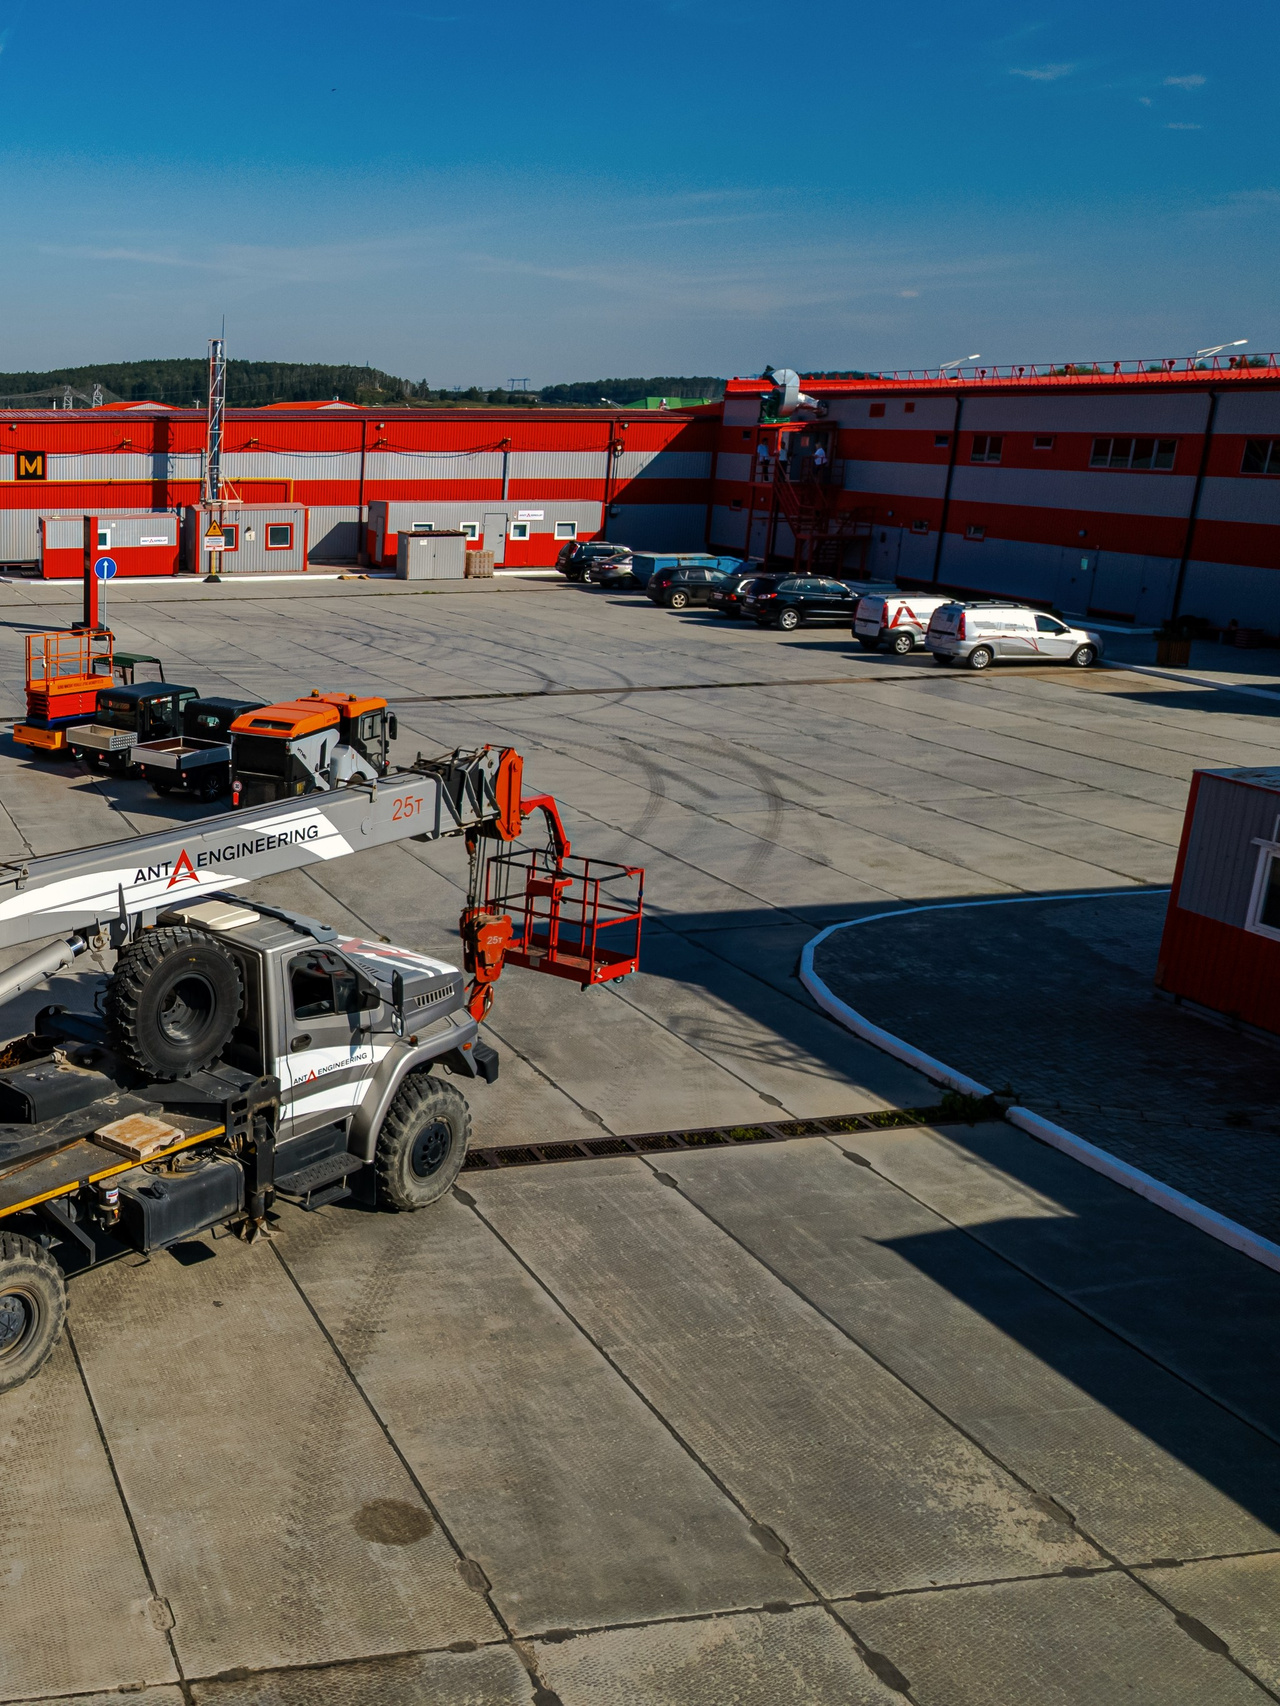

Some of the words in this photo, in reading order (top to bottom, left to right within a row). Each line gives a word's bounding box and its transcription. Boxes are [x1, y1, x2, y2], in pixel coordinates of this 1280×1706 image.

[20, 455, 42, 476] M
[134, 861, 172, 884] ANT
[197, 825, 319, 868] ENGINEERING
[293, 1074, 308, 1085] ANT
[317, 1052, 368, 1075] ENGINEERING
